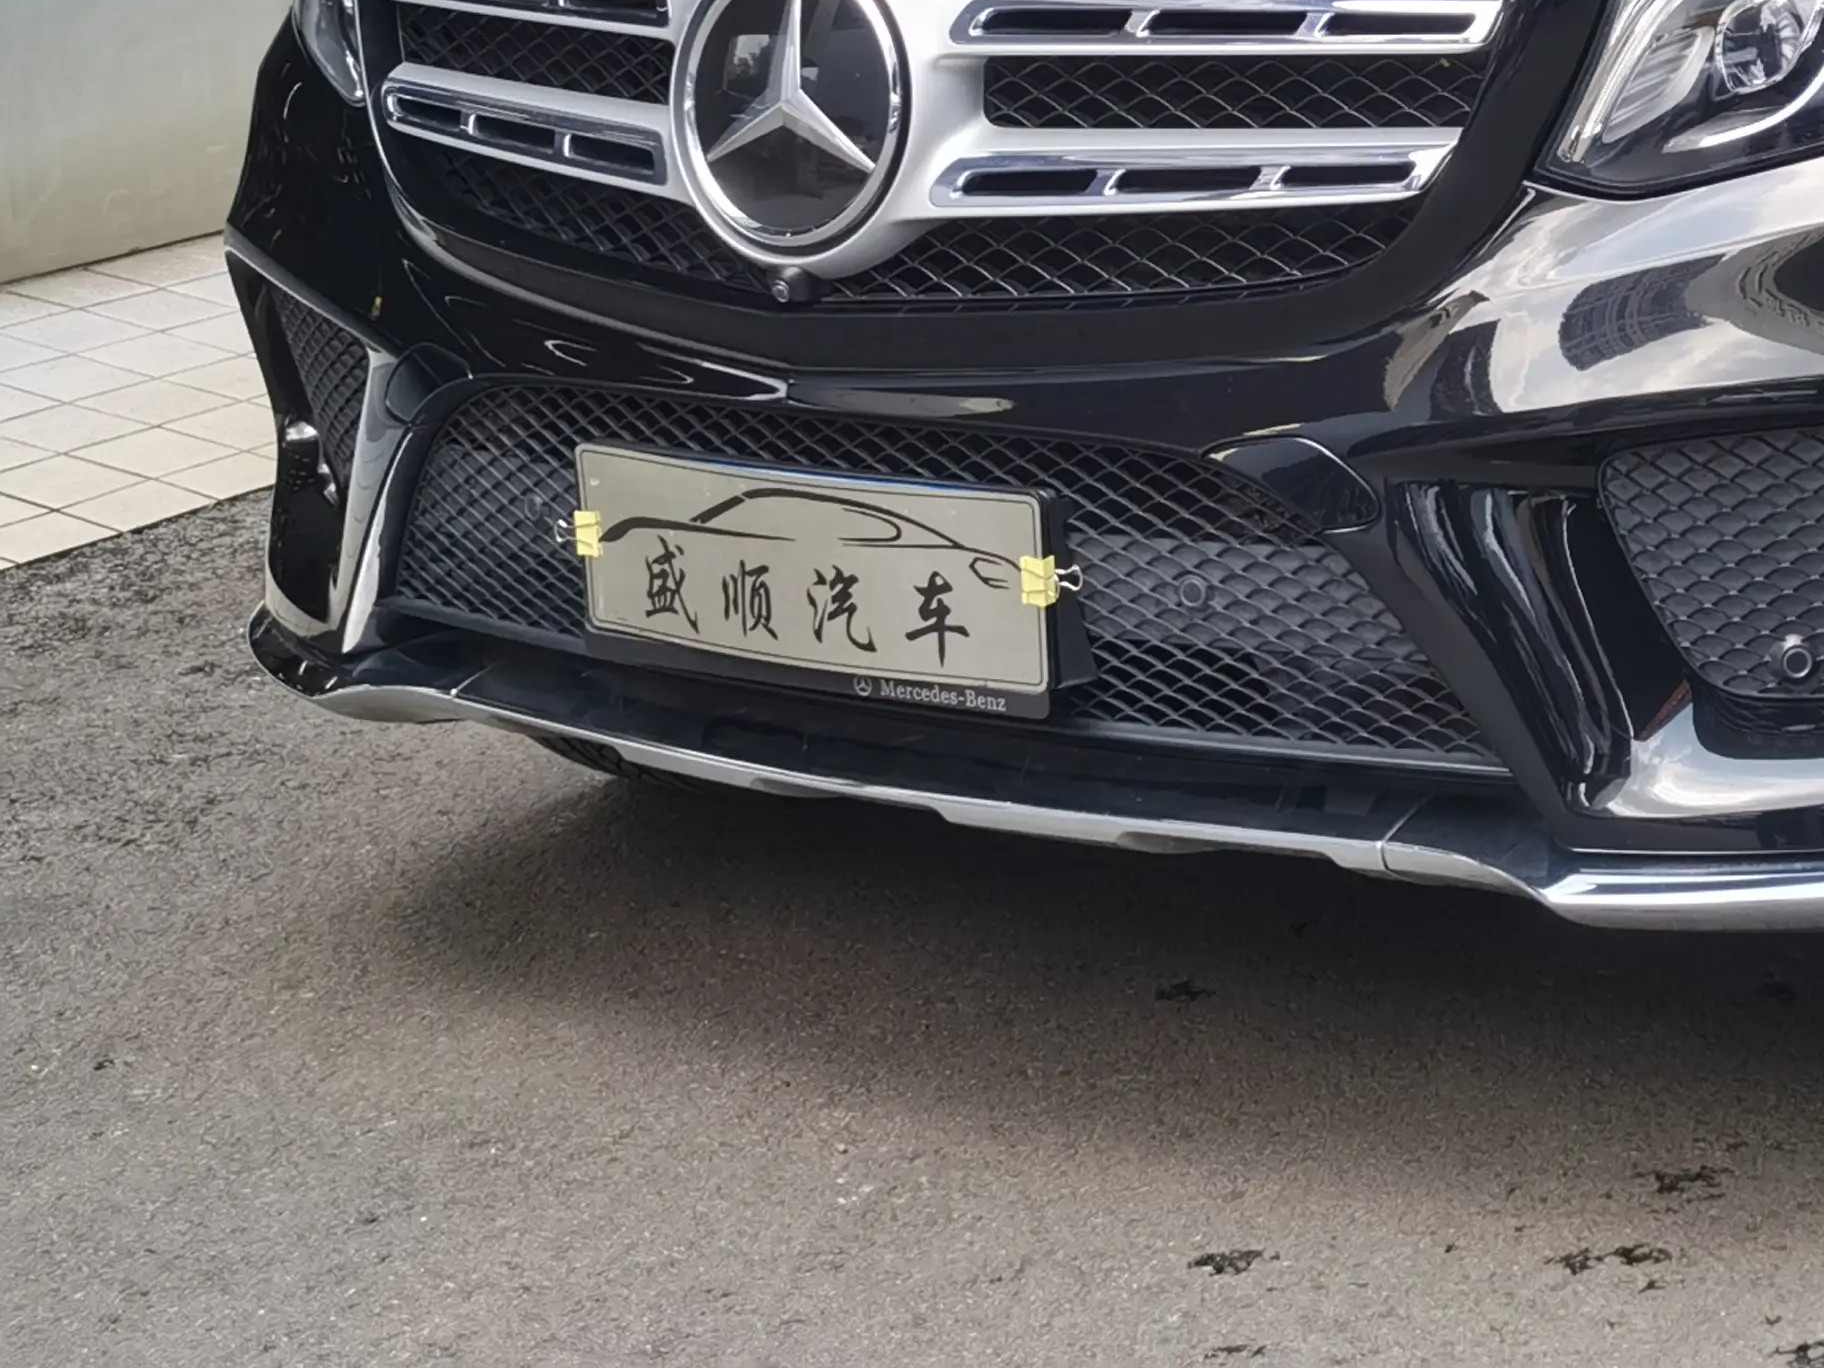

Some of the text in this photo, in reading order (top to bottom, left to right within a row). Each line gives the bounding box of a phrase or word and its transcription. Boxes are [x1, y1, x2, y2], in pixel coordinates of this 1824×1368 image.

[643, 534, 971, 669] 盛顺汽车
[879, 682, 1007, 714] Mercedes-Benz
